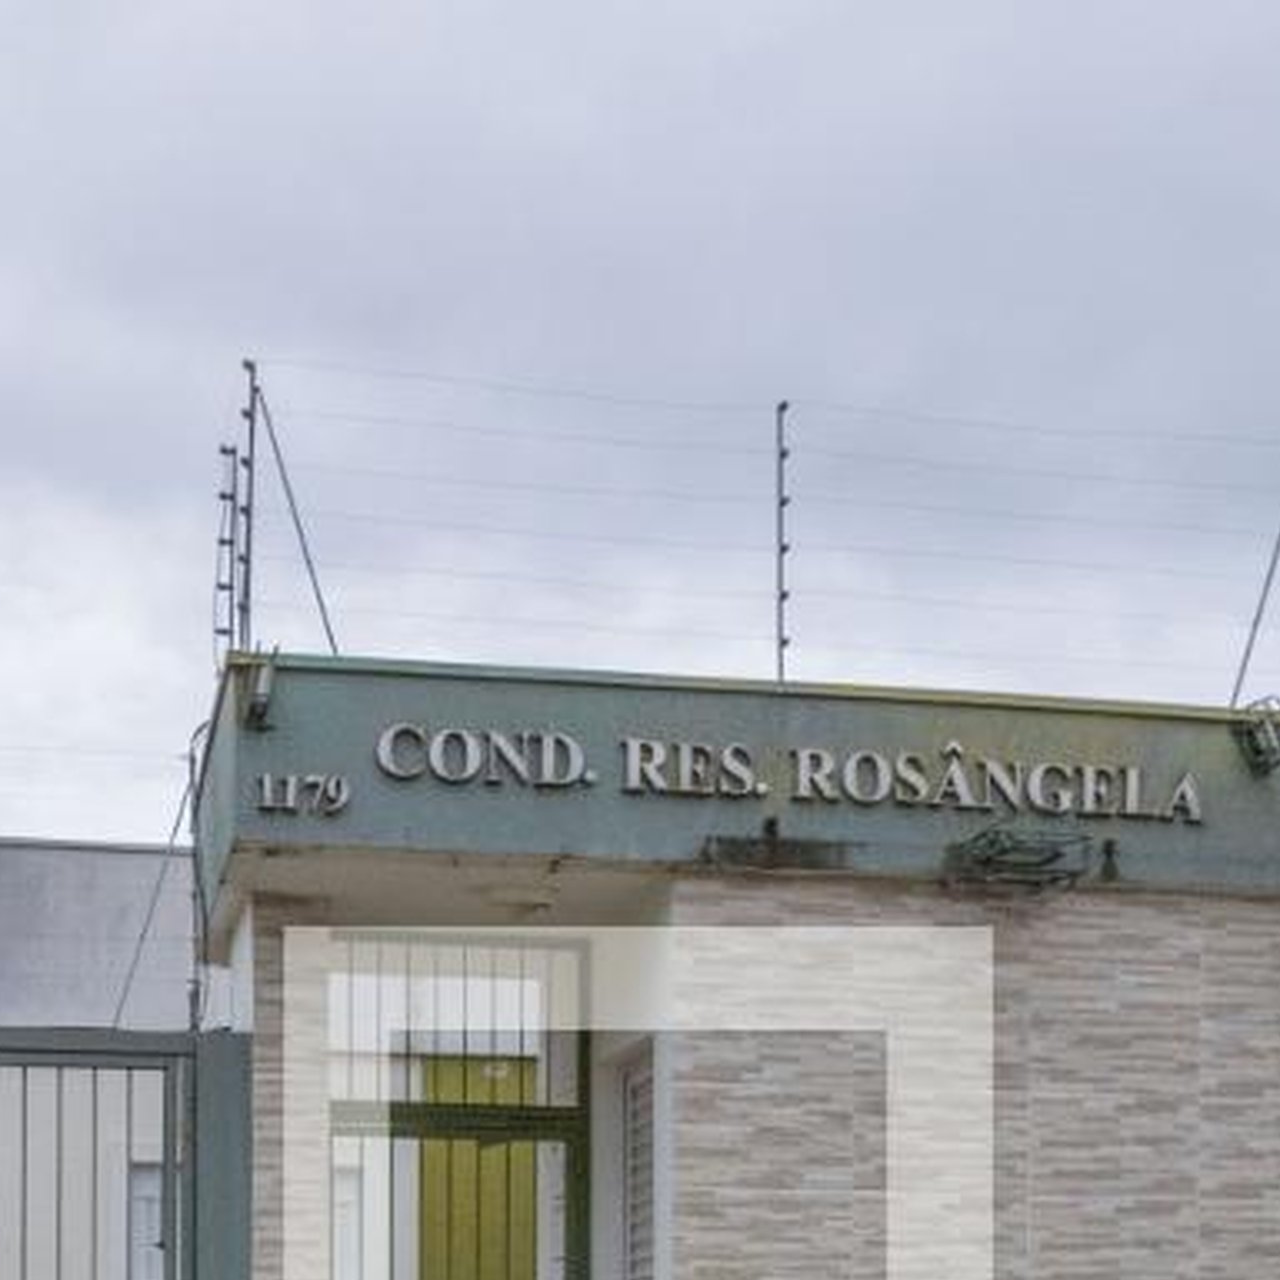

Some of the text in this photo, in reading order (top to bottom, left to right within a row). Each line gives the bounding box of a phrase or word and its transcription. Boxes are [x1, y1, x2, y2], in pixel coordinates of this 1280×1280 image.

[259, 774, 350, 816] 1179
[377, 722, 1202, 823] COND. RES. ROSÂNGELA
